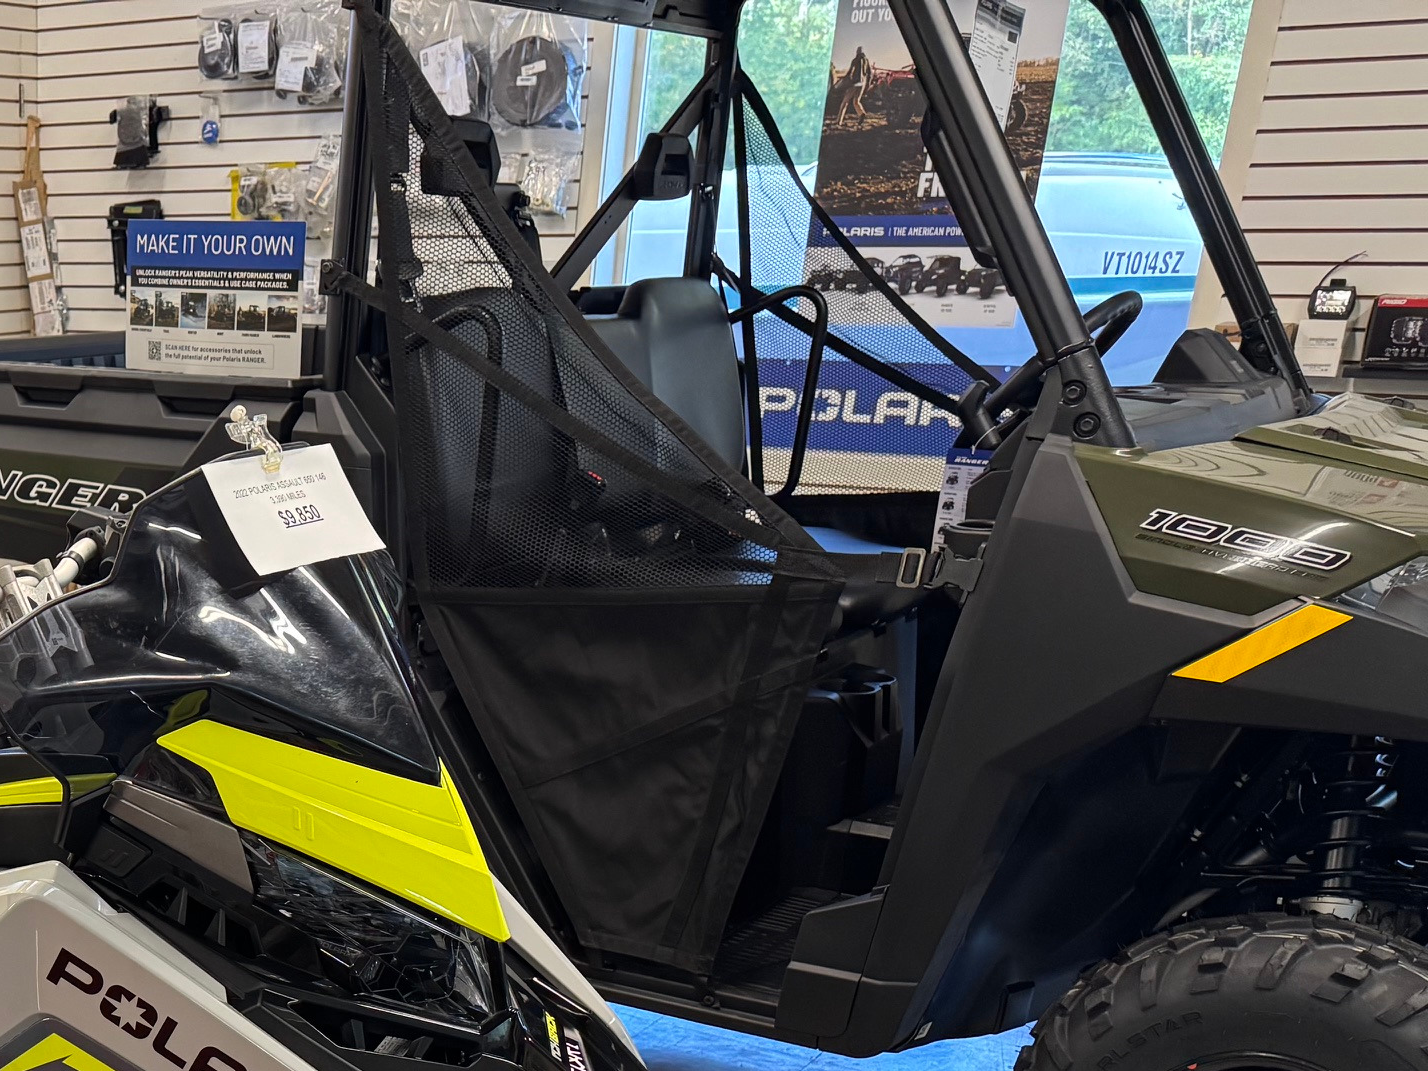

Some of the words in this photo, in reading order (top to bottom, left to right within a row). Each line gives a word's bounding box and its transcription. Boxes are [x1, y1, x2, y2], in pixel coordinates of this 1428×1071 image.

[851, 9, 875, 23] OUT
[893, 226, 906, 236] THE
[907, 226, 945, 237] AMERICAN
[136, 233, 179, 254] MAKE
[183, 234, 198, 255] IT
[201, 234, 247, 256] YOUR
[251, 235, 294, 256] OWN
[1102, 250, 1185, 275] VT1014SZ
[194, 270, 227, 278] VERSATILITY
[192, 279, 224, 287] ESSENTIALS
[242, 280, 256, 288] CASE
[257, 281, 289, 289] PACKAGES.
[181, 354, 203, 362] potential
[248, 483, 277, 496] POLARIS
[276, 477, 303, 490] ASSAULT
[278, 504, 322, 527] $9,850
[1139, 508, 1352, 571] 1000
